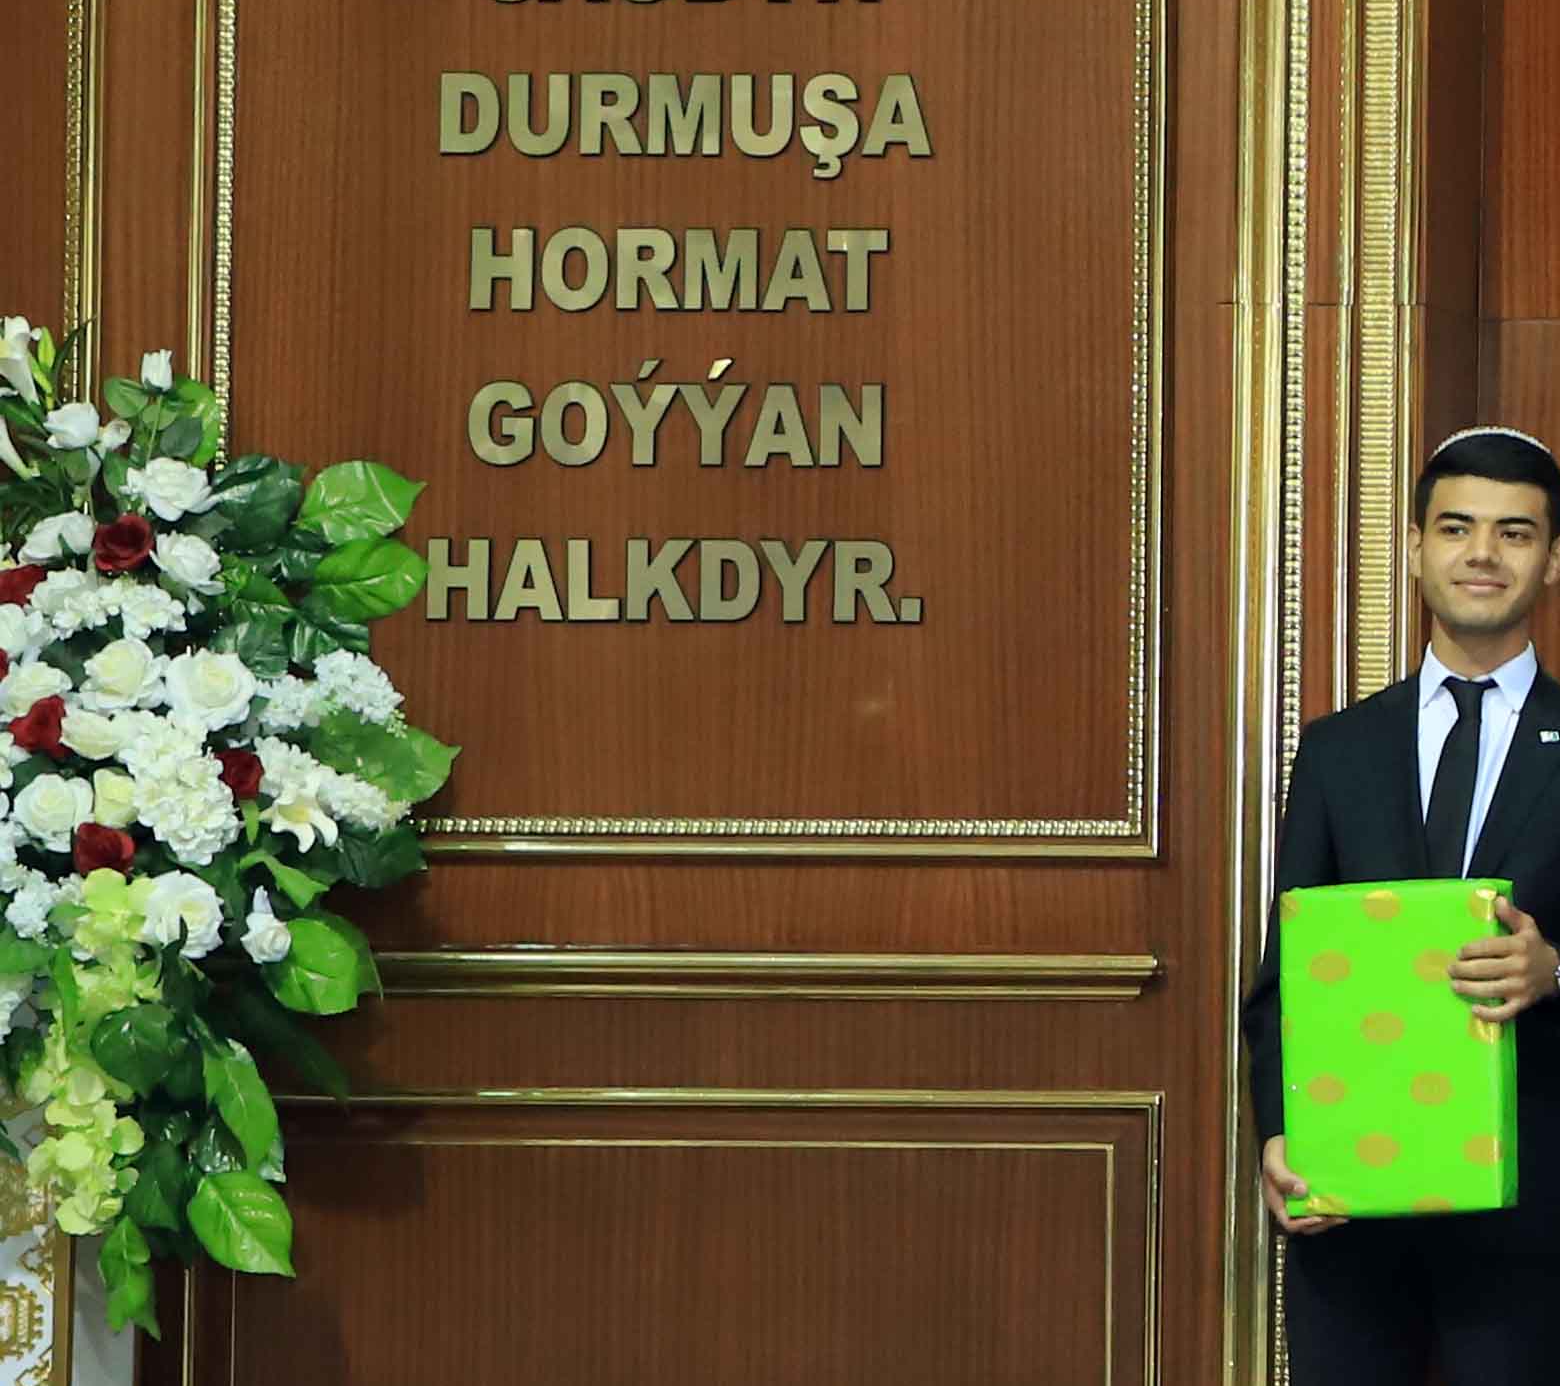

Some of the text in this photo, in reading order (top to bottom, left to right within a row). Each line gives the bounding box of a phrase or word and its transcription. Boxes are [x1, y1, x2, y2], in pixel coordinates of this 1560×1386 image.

[438, 72, 932, 179] DURMUŞA
[468, 226, 889, 312] HORMAT
[467, 357, 883, 467] GOÝÝAN
[424, 537, 922, 623] HALKDYR.
